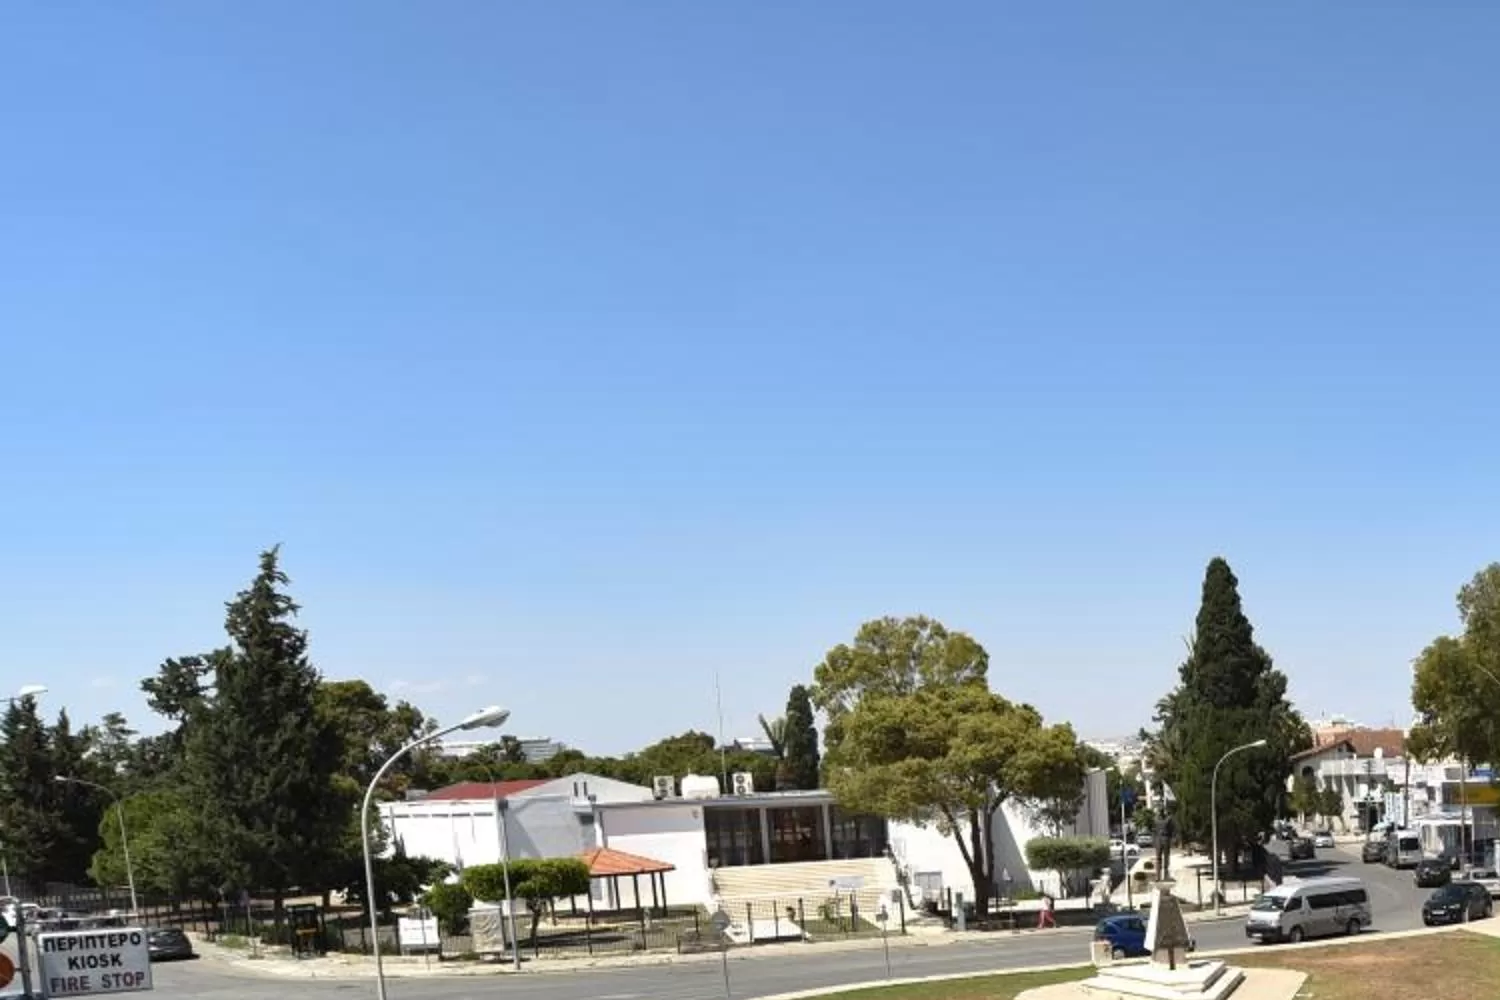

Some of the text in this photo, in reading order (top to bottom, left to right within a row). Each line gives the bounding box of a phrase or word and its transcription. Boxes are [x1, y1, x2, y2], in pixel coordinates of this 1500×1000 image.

[43, 932, 141, 952] ΠΕΡΙΠΤΕΡΟ
[67, 953, 122, 970] KIOSK
[50, 971, 145, 993] FIRE STOP
